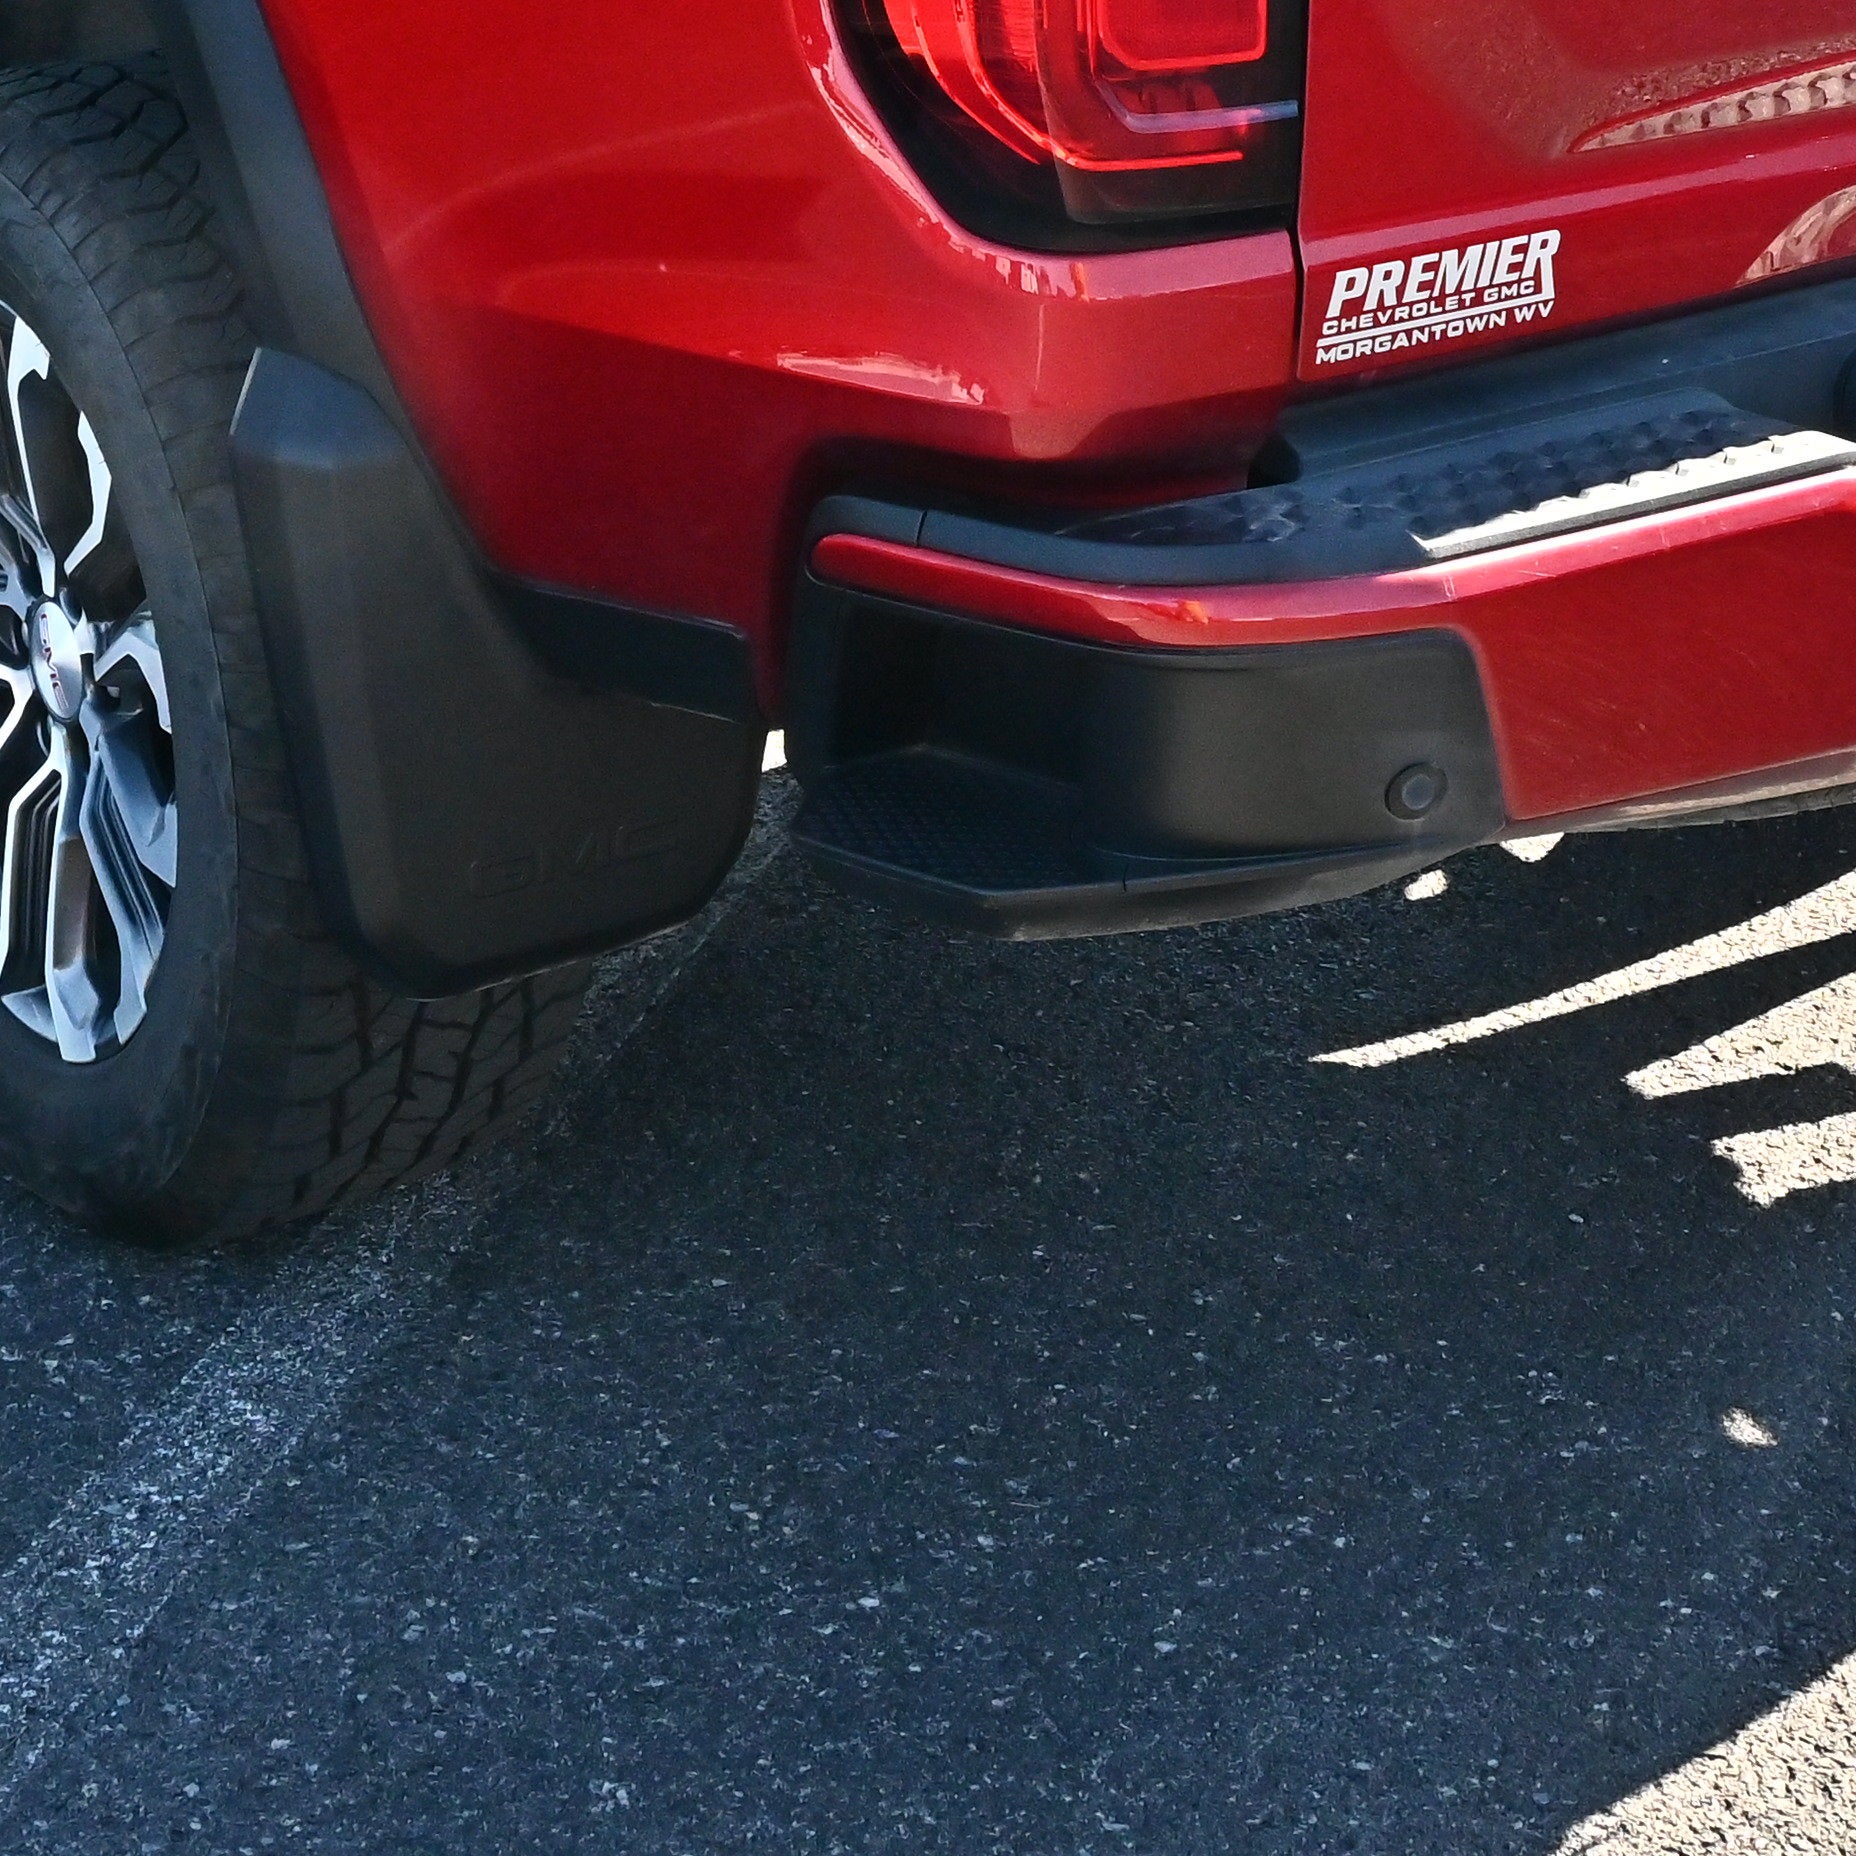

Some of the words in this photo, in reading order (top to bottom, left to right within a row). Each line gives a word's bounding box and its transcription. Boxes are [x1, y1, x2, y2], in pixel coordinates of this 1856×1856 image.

[1325, 229, 1561, 319] PREMIER
[1315, 310, 1506, 365] MORGANTOWN
[1514, 300, 1555, 324] WV
[1322, 292, 1476, 336] CHEVROLET
[1483, 280, 1535, 303] GMC
